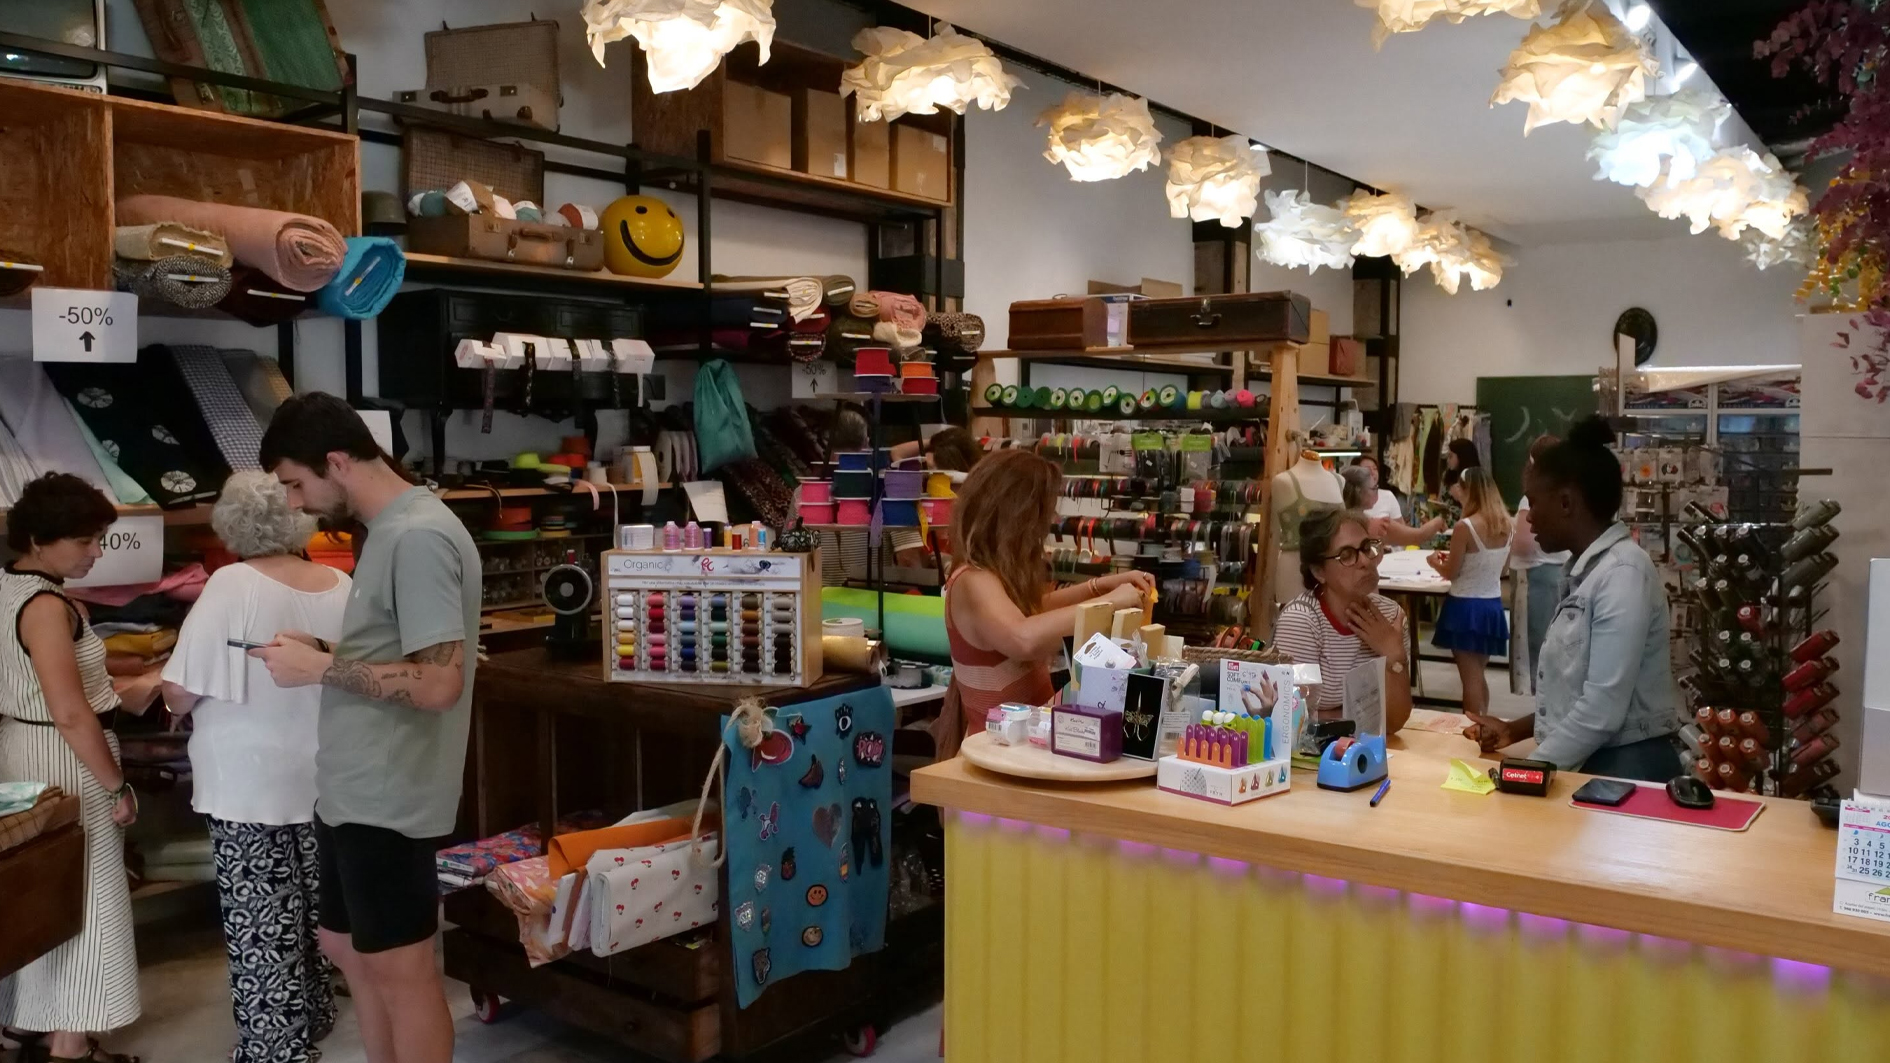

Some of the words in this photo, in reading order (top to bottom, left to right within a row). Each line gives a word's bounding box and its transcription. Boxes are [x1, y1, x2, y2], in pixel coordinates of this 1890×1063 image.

[58, 306, 114, 326] -50%
[623, 559, 663, 572] Organic
[1282, 680, 1291, 744] ERGONOMICS
[1854, 838, 1859, 846] 3
[1867, 840, 1872, 848] 4
[1880, 842, 1885, 850] 5
[1848, 847, 1859, 855] 10
[1861, 848, 1870, 857] 11
[1874, 850, 1884, 859] 12
[1848, 856, 1858, 864] 17
[1860, 857, 1871, 866] 18
[1873, 859, 1884, 868] 19
[1859, 866, 1870, 875] 25
[1872, 868, 1883, 877] 26
